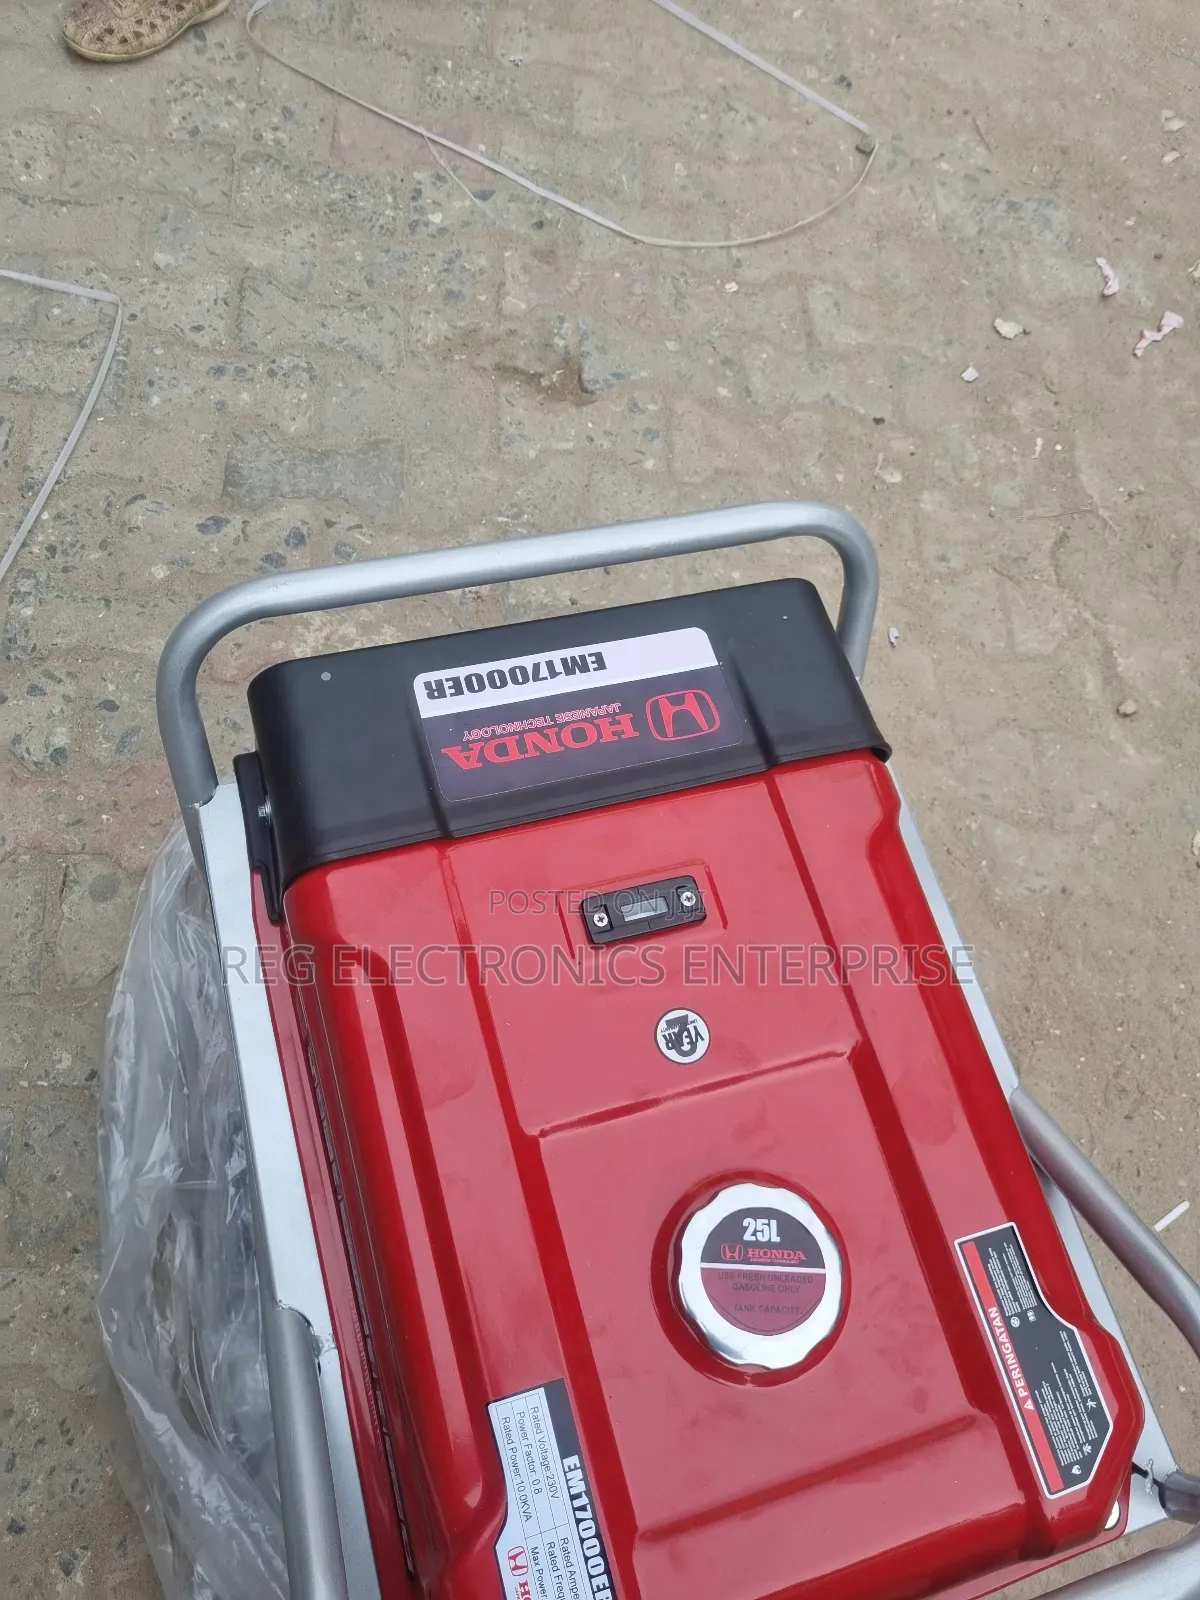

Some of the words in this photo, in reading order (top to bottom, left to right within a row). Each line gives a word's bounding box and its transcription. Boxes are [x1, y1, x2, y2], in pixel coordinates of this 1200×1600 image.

[424, 651, 607, 700] EM17000ER
[556, 703, 622, 723] JAPANESE
[441, 713, 640, 770] HONDA
[463, 717, 554, 741] TECHNOLOGY
[661, 1025, 705, 1051] YEAR
[742, 1217, 781, 1243] 25L
[747, 1248, 807, 1261] HONDA
[717, 1271, 736, 1281] USE
[737, 1272, 765, 1281] FRESH
[767, 1273, 814, 1284] UNLEADED
[732, 1283, 776, 1292] GASOLINE
[777, 1284, 800, 1293] ONLY
[734, 1303, 756, 1313] TANK
[988, 1307, 1031, 1398] PERINGATAN
[501, 1416, 515, 1446] Rated
[516, 1411, 529, 1442] Power
[532, 1477, 543, 1495] 0.8
[530, 1405, 544, 1435] Rated
[538, 1437, 560, 1499] Voltage:230V
[530, 1546, 541, 1567] Max
[546, 1541, 560, 1573] Rated
[561, 1537, 575, 1569] Rated
[567, 1570, 580, 1600] Ampe
